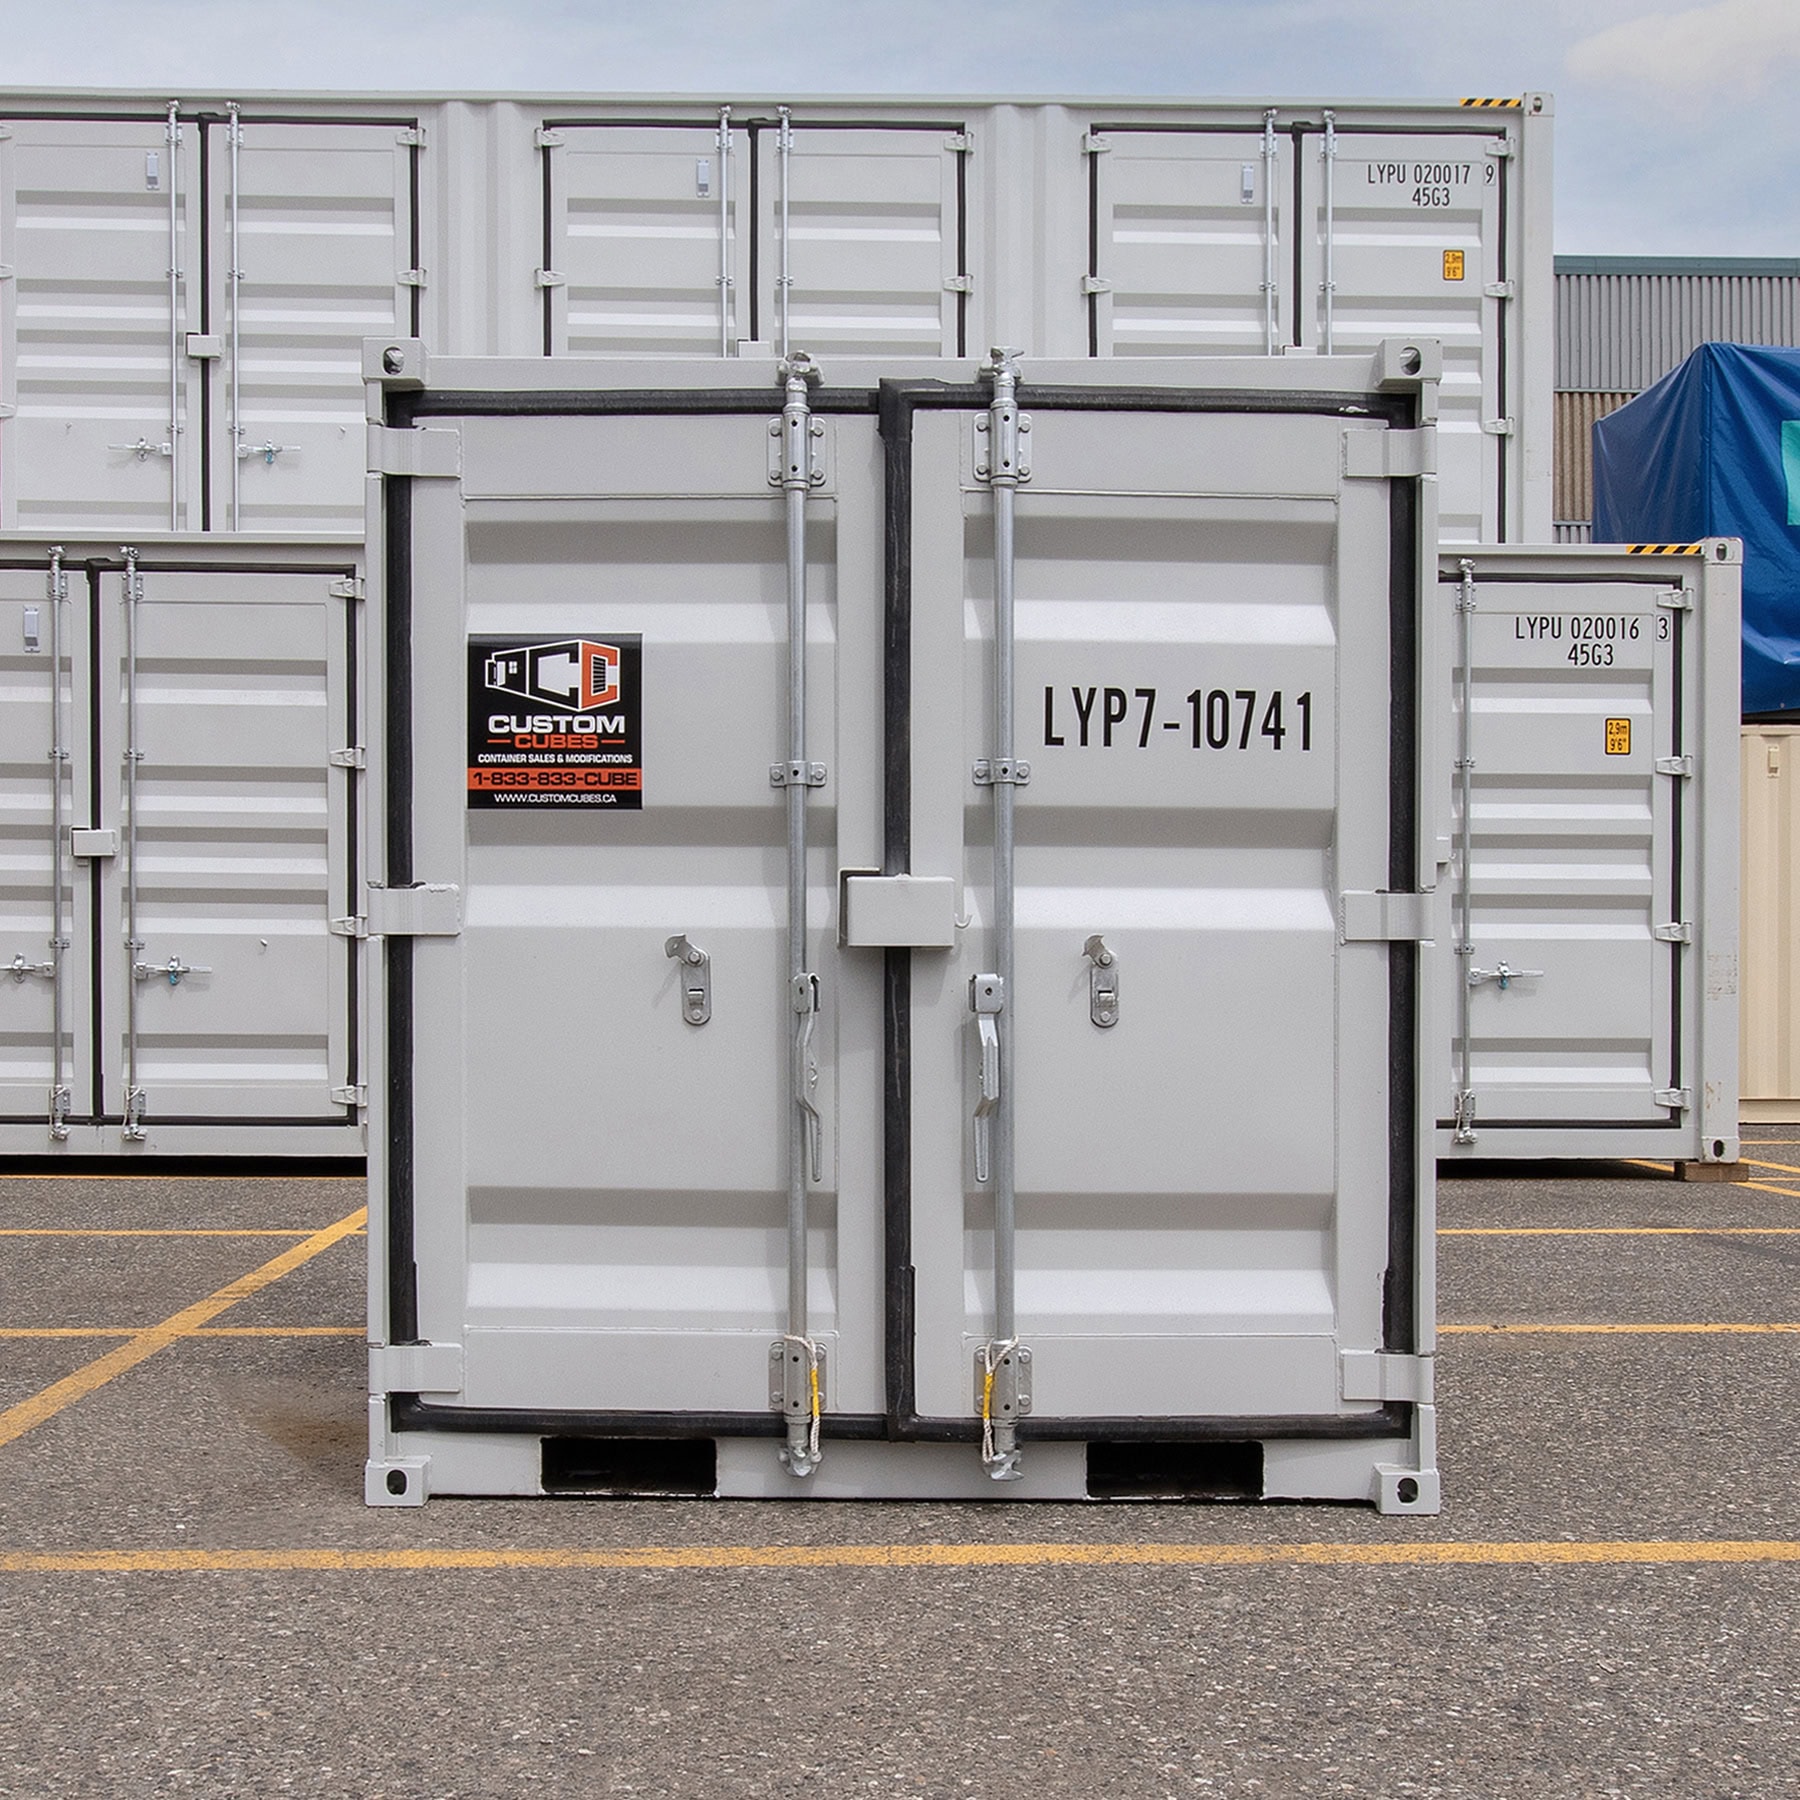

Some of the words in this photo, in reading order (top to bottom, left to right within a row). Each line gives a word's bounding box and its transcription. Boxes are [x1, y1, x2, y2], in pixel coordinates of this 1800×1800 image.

[1367, 164, 1406, 184] LYPU
[1413, 164, 1471, 184] 020017
[1485, 164, 1495, 184] 9
[1411, 186, 1451, 206] 45G3
[1515, 616, 1562, 639] LYPU
[1570, 617, 1640, 640] 020016
[1658, 617, 1669, 640] 3
[1567, 643, 1614, 666] 45G3
[488, 714, 626, 733] CUSTOM
[1043, 686, 1312, 751] LYP7-10741
[513, 734, 599, 749] CUBES
[477, 753, 527, 763] CONTAINER
[528, 753, 555, 763] SALES
[556, 753, 564, 763] &
[565, 753, 633, 763] MODIFICATIONS
[473, 772, 638, 786] 1-833-833-CUBE
[493, 793, 617, 803] WWW.CUSTOMCUBES.CA
